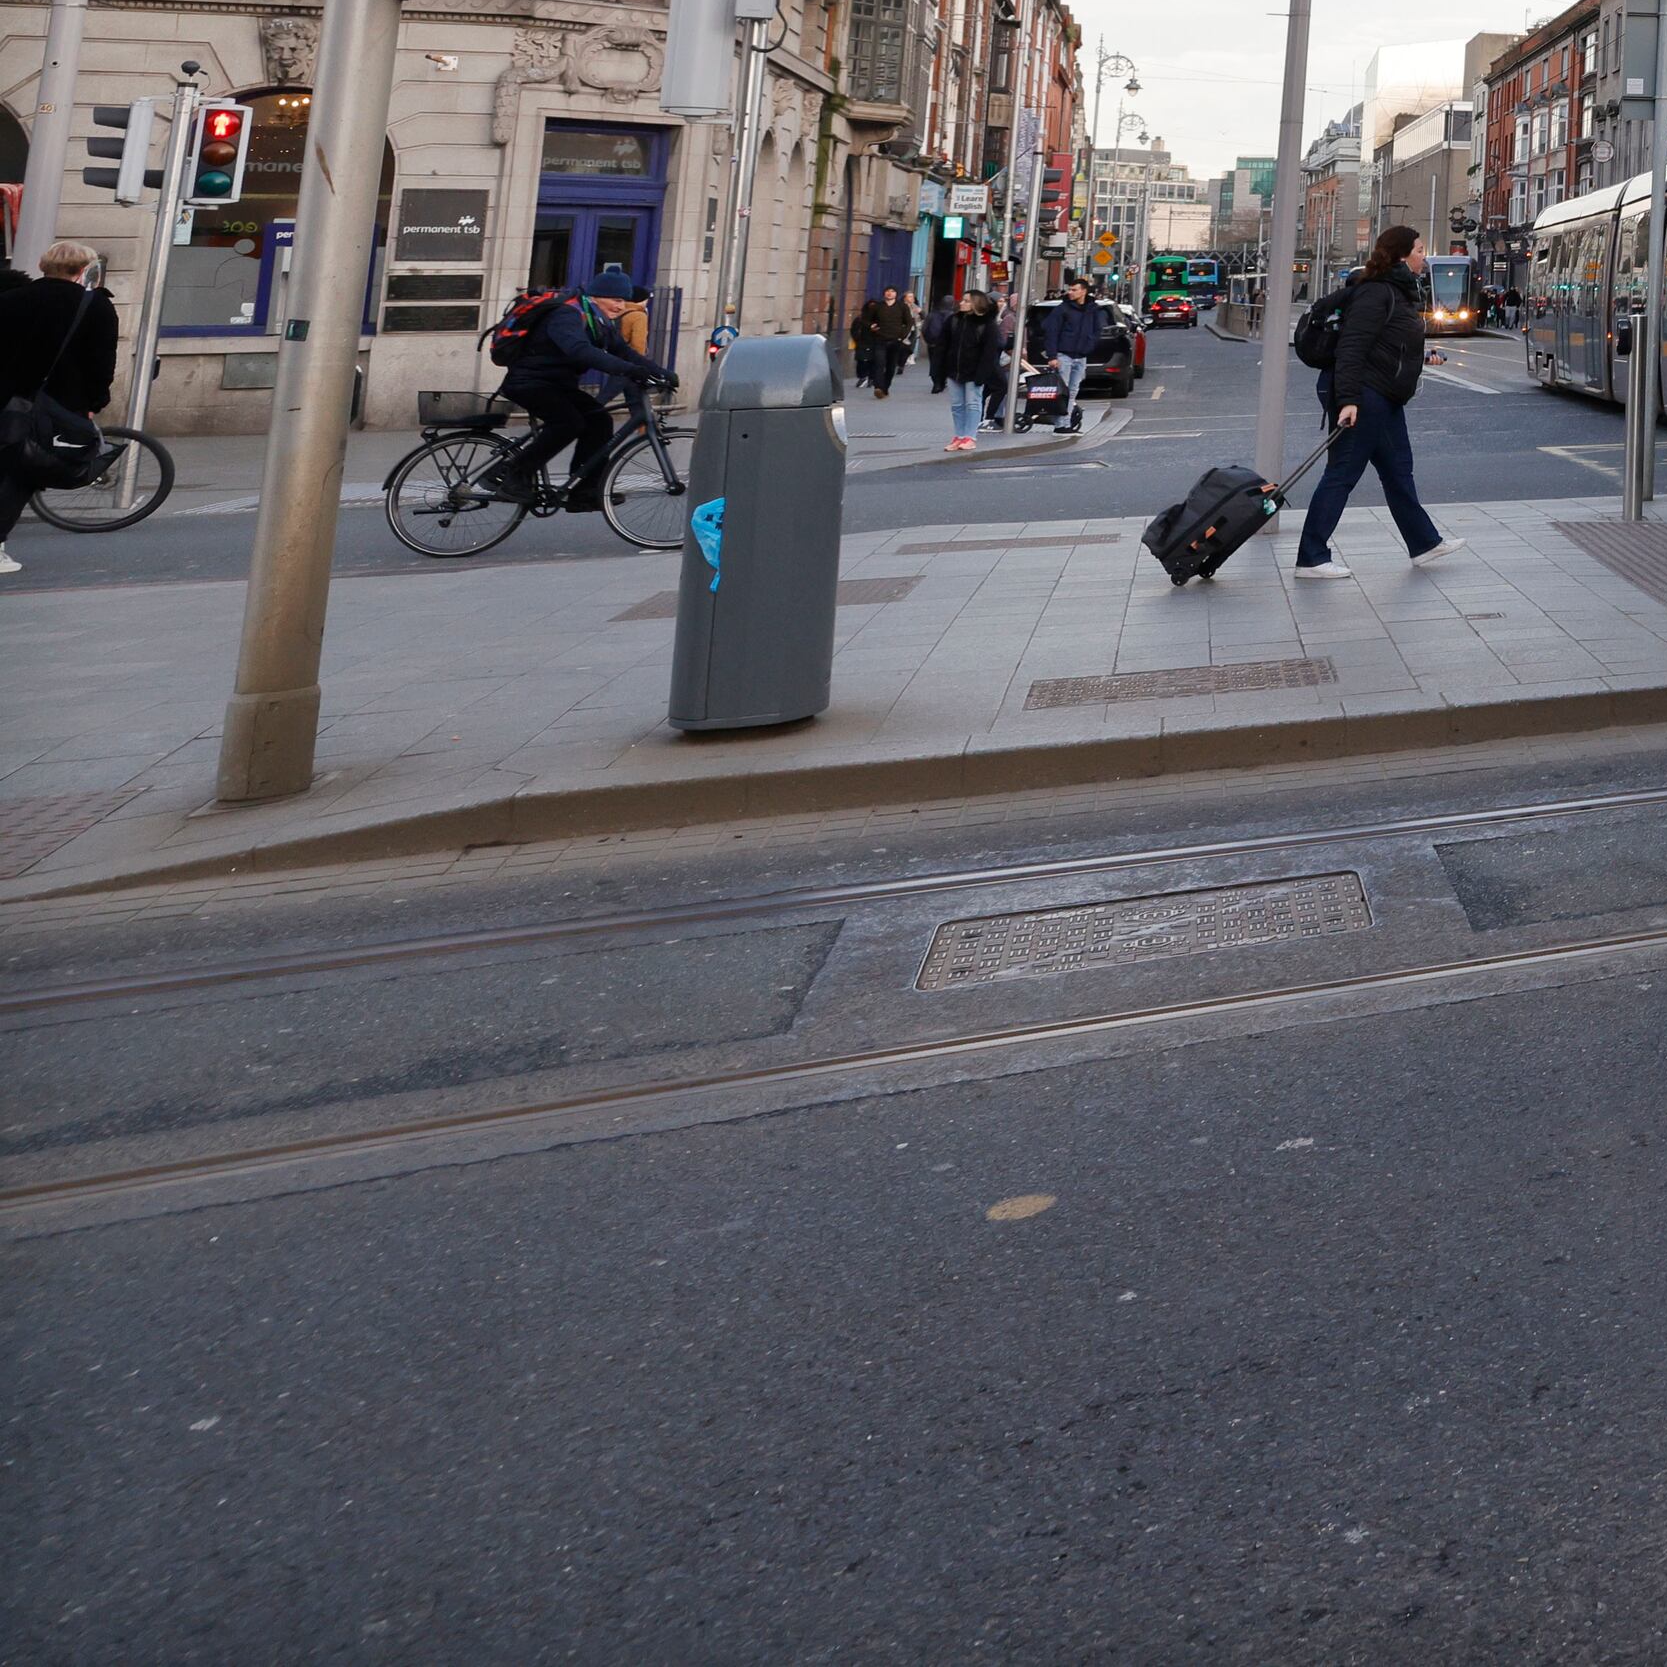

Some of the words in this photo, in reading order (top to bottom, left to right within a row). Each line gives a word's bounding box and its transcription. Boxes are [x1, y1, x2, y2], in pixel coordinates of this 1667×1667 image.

[542, 156, 617, 169] permanent
[621, 158, 641, 170] tsb
[953, 202, 983, 211] English
[403, 224, 461, 234] permanent
[463, 223, 480, 234] tsb
